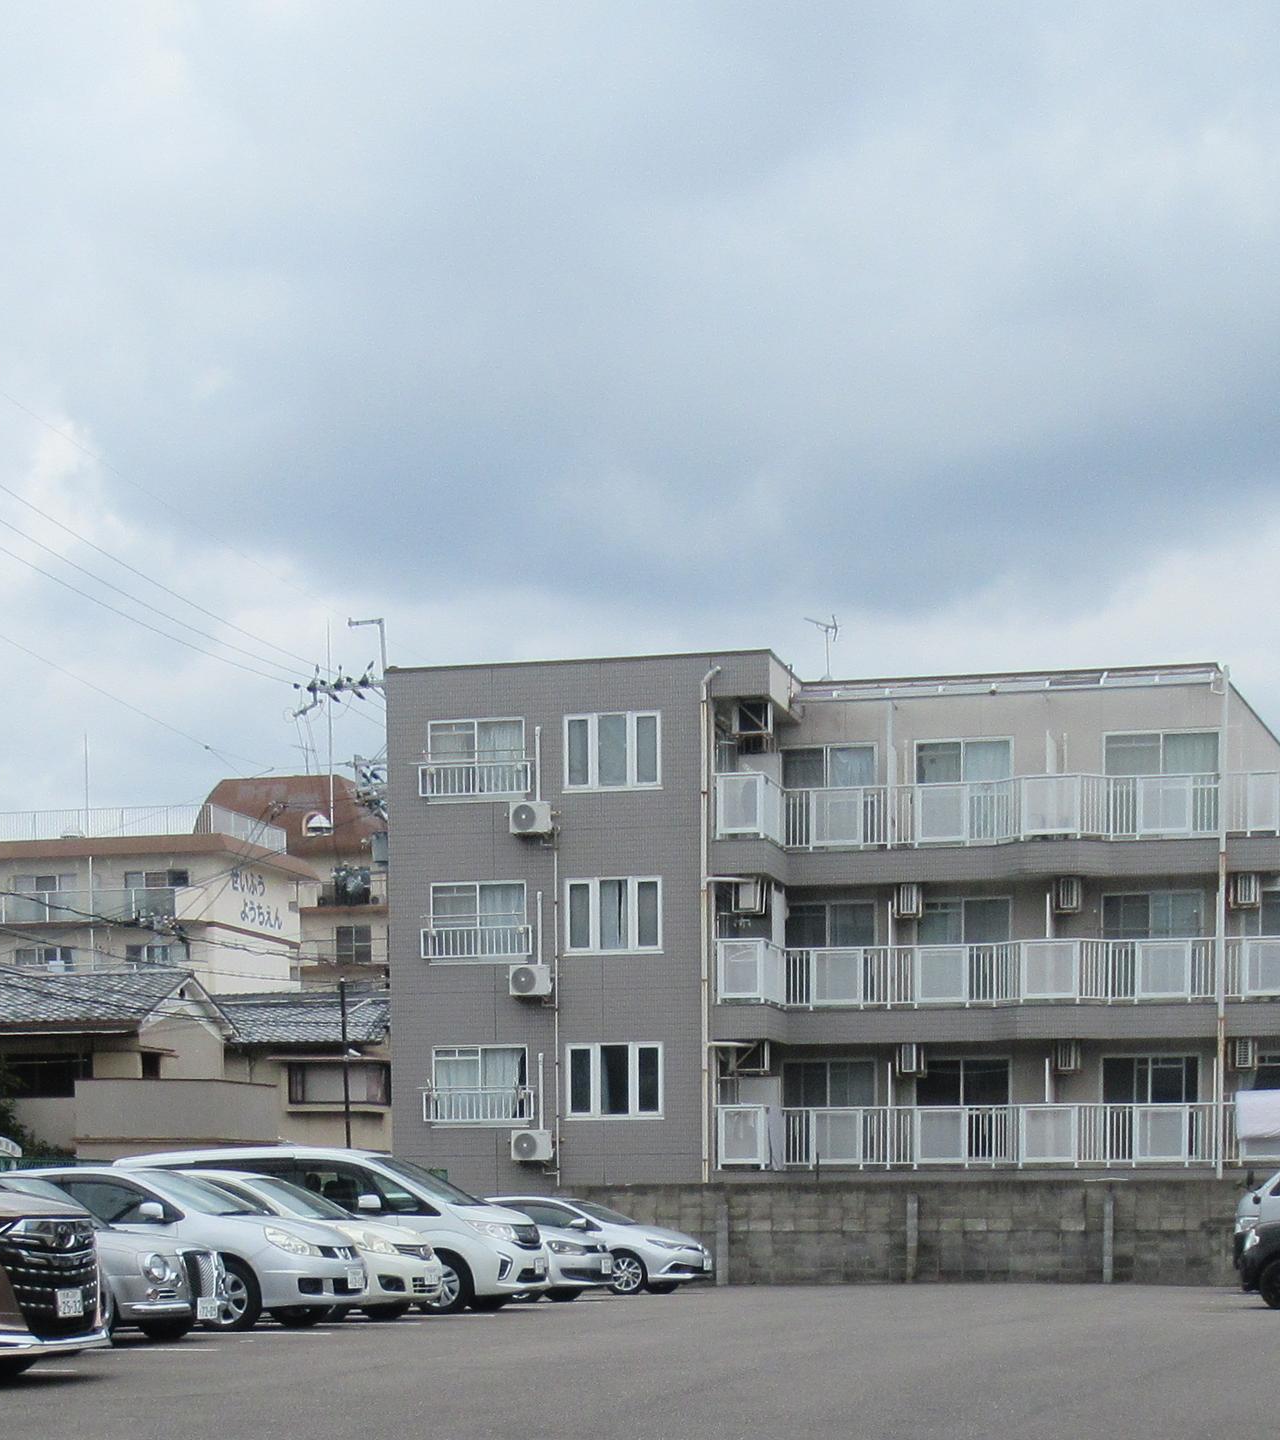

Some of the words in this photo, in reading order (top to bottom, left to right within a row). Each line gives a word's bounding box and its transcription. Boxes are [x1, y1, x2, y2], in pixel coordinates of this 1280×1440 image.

[231, 868, 266, 897] せいふう
[240, 897, 283, 931] ようちえん
